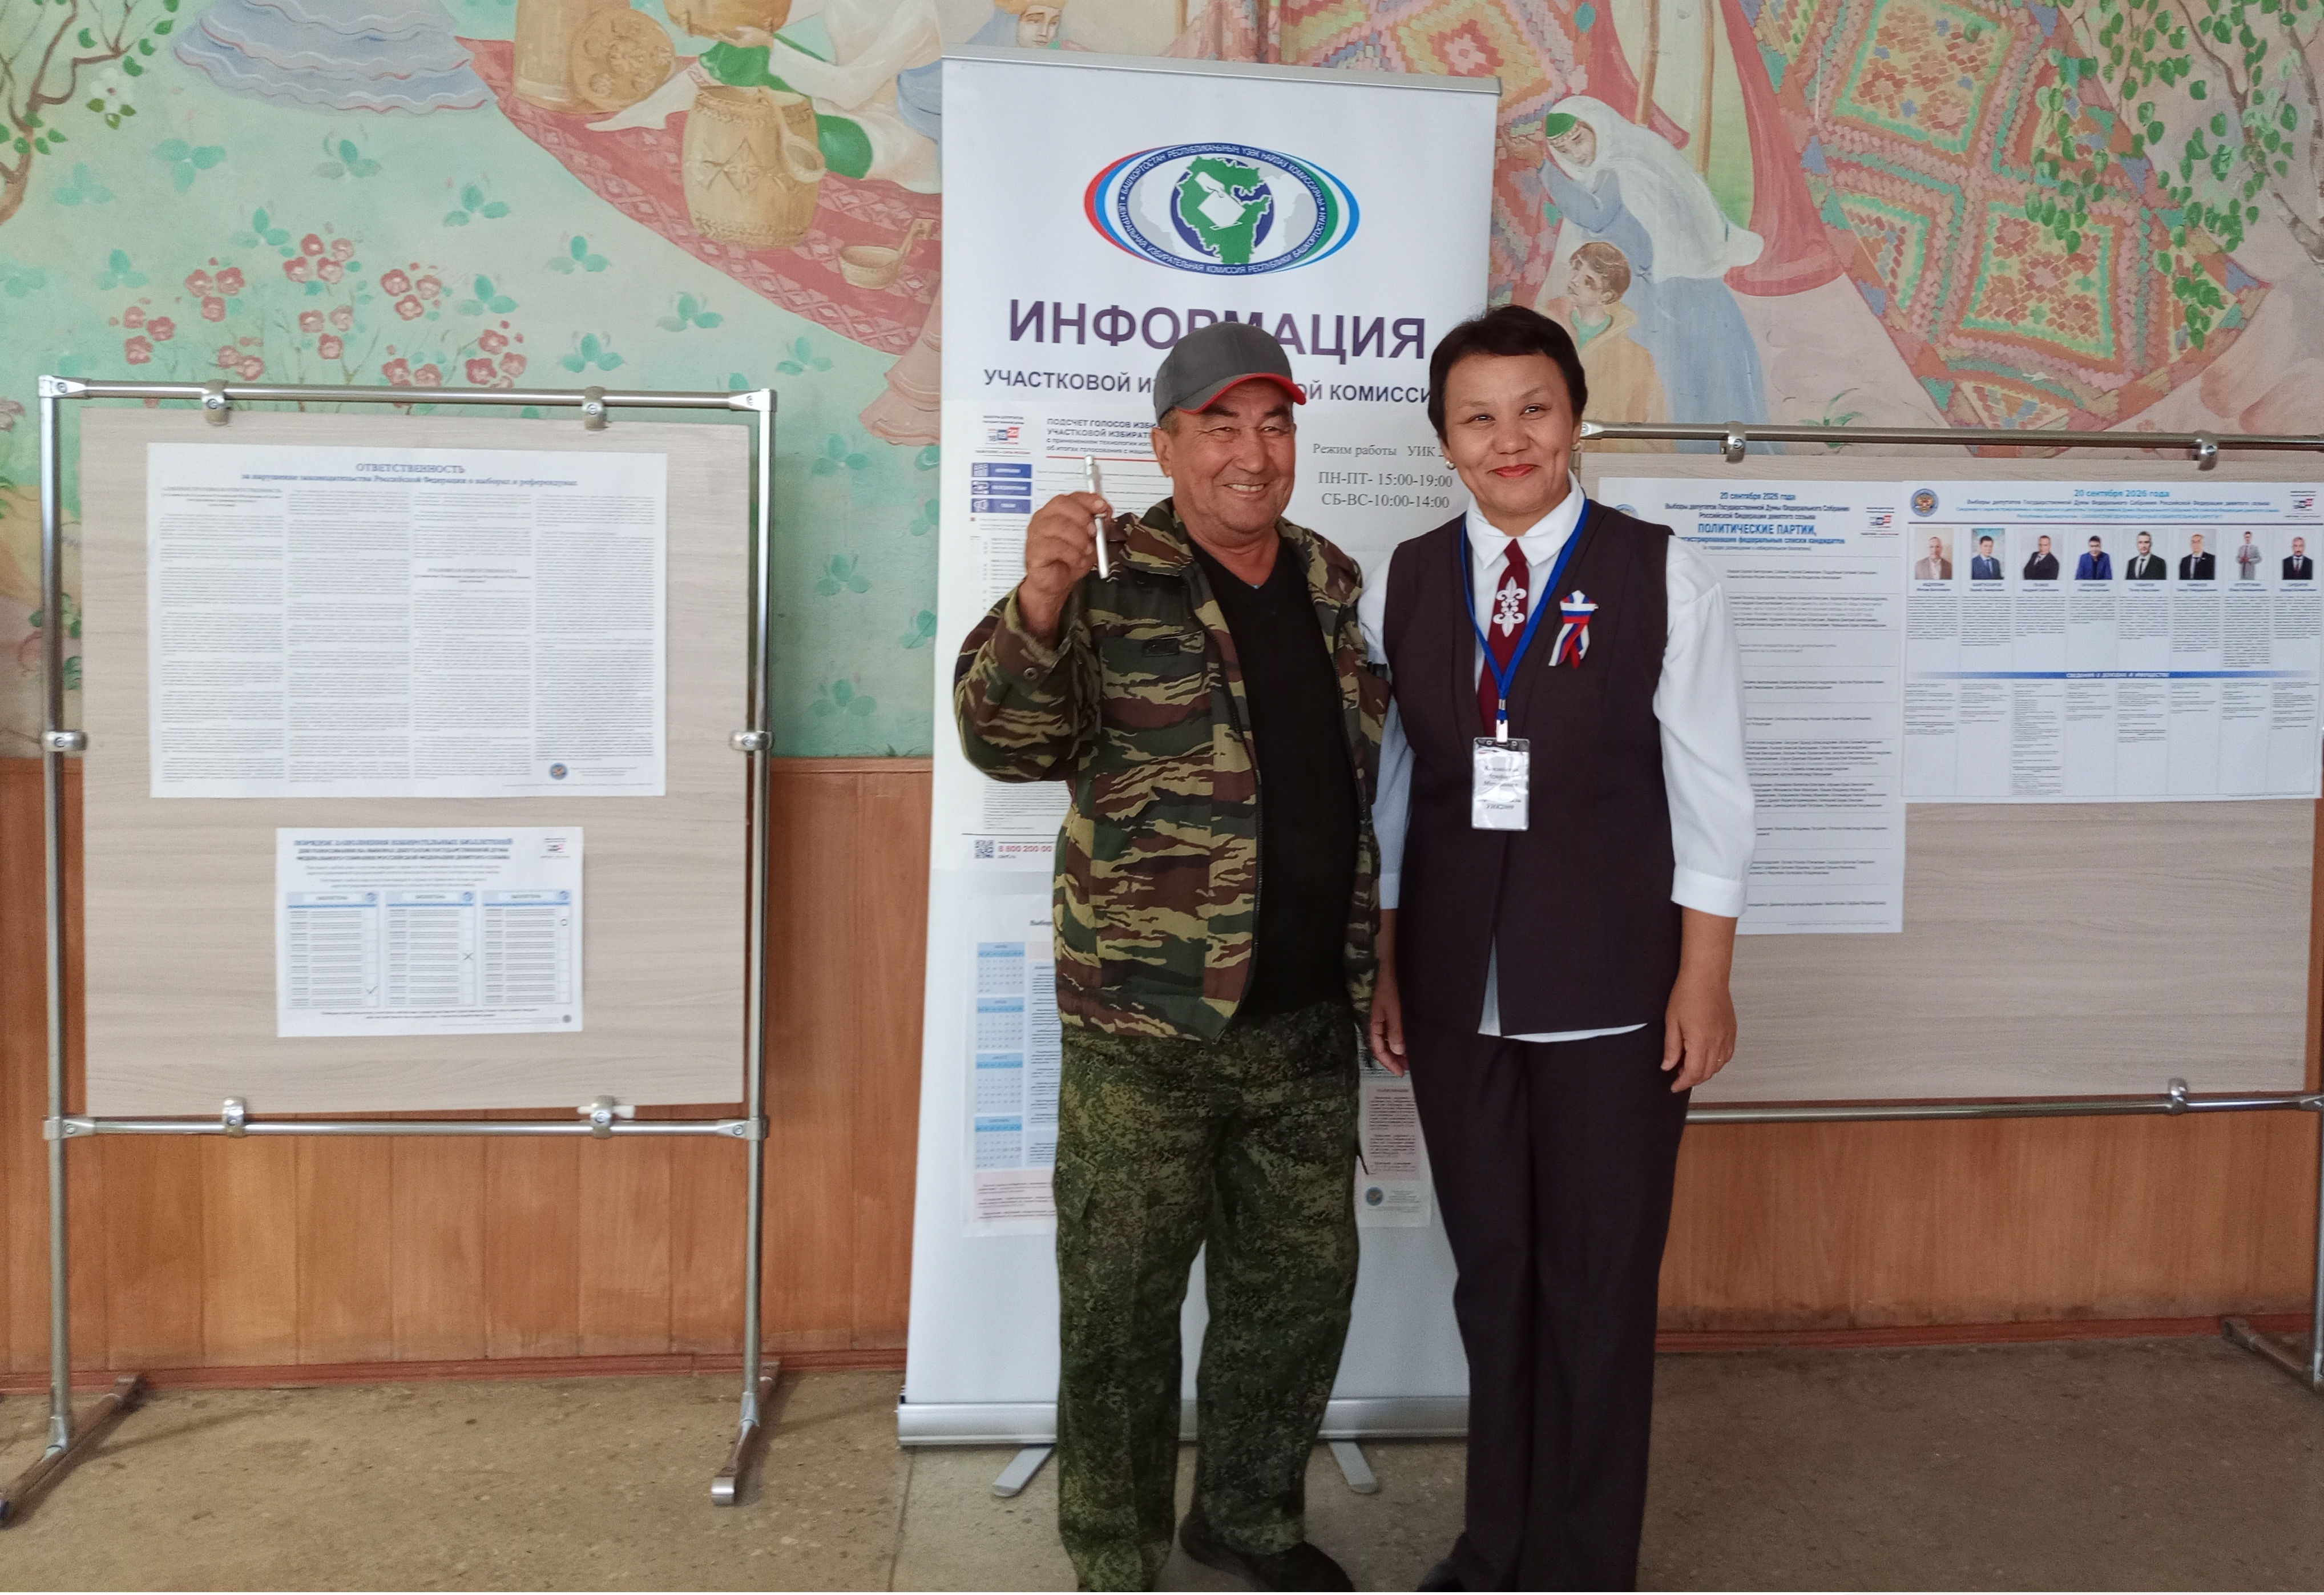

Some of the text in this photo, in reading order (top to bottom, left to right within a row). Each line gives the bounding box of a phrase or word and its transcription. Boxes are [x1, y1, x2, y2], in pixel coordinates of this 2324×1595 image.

[1010, 299, 1426, 365] ИНФОРАЦИЯ
[983, 369, 1131, 393] УЧАСТКОВОЙ
[1330, 383, 1431, 403] КОМИССИ
[1090, 420, 1131, 428] ГОЛОСОВ
[1047, 428, 1107, 437] УЧАСТКОВОЙ
[1313, 443, 1351, 455] Режим
[1355, 444, 1397, 458] работы
[1407, 445, 1436, 457] УИК
[356, 464, 465, 473] ОТВЕТСТВЕННОСТЬ
[1318, 472, 1453, 487] ПН-ПТ- 15:00-19:00
[1698, 523, 1817, 537] ПОЛИТИЧЕСКИЕ ПАРТИИ,
